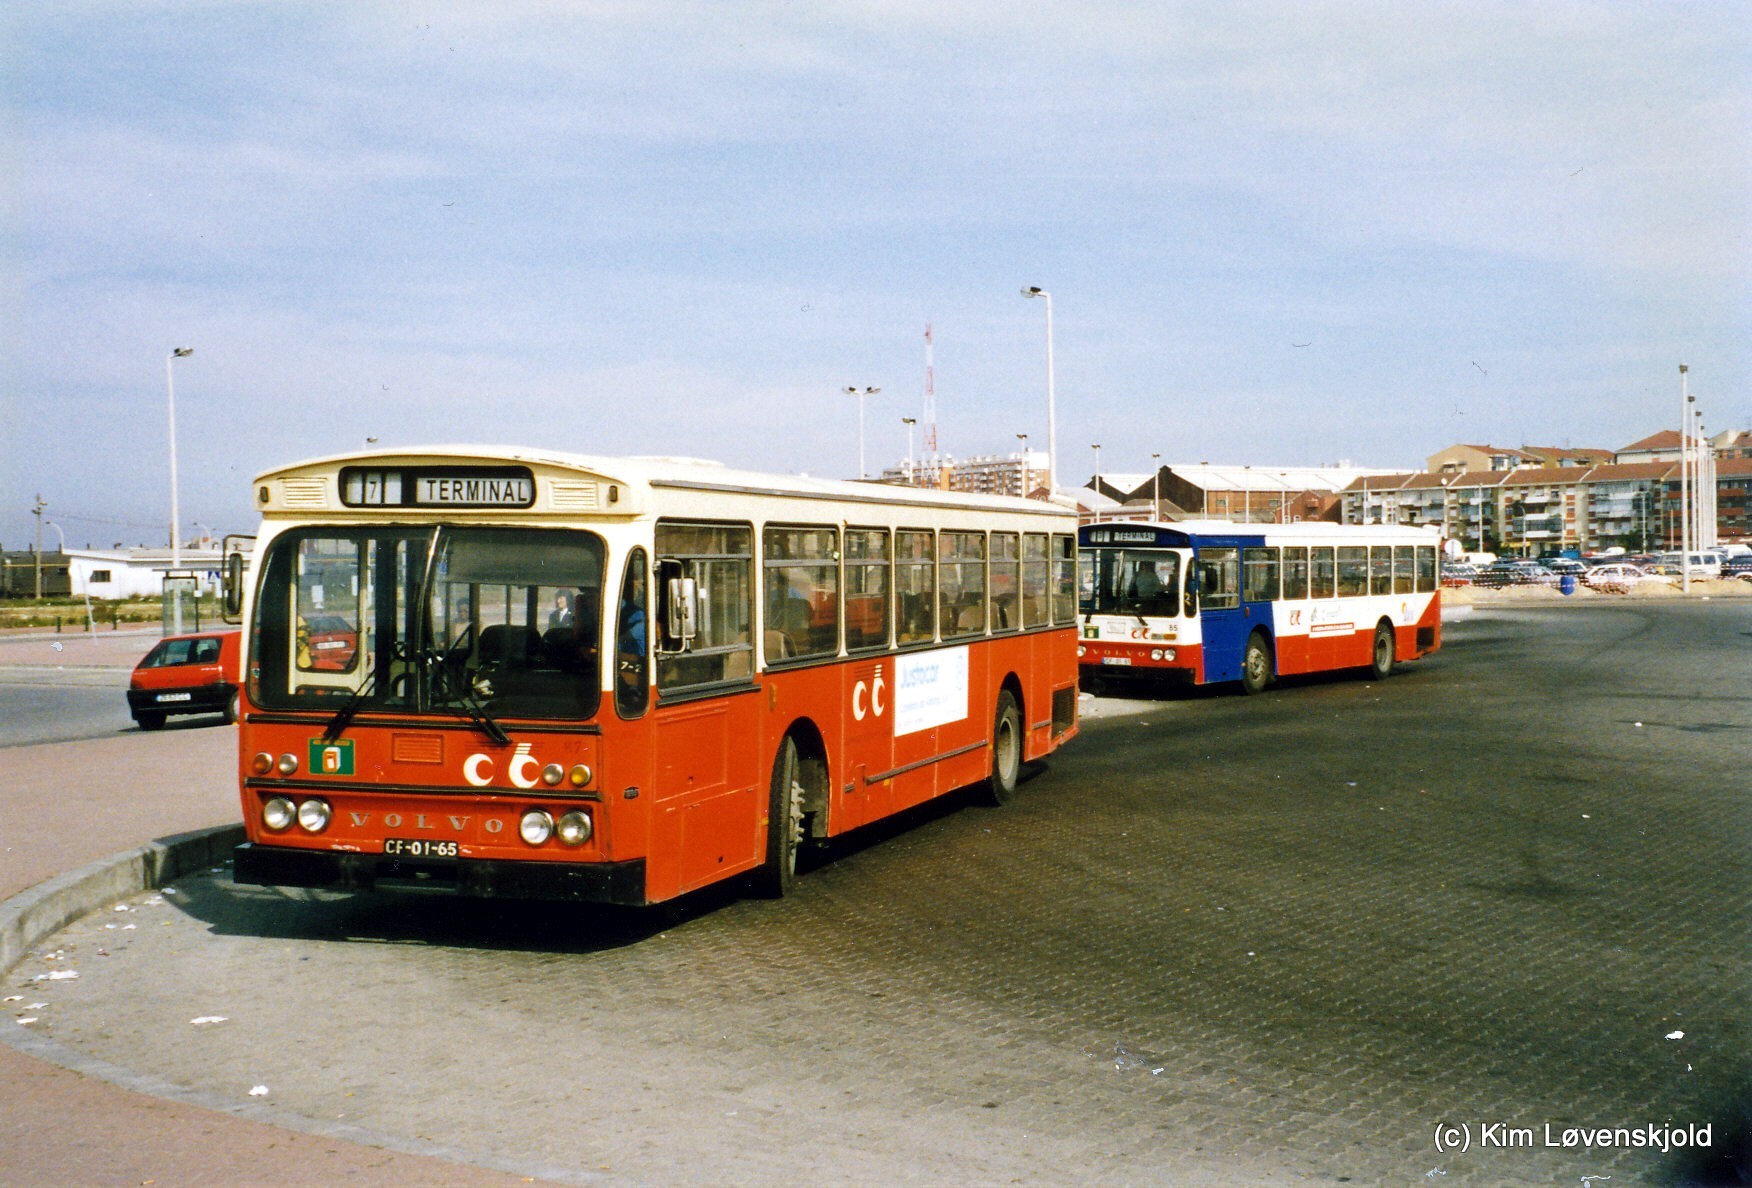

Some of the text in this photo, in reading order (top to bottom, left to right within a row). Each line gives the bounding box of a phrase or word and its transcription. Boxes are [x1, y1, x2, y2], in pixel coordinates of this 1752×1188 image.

[369, 480, 378, 499] 7
[426, 479, 528, 502] TERMINAL
[1092, 648, 1146, 657] VOLVO
[349, 812, 504, 833] VOLVO
[384, 839, 458, 857] CF-01-65
